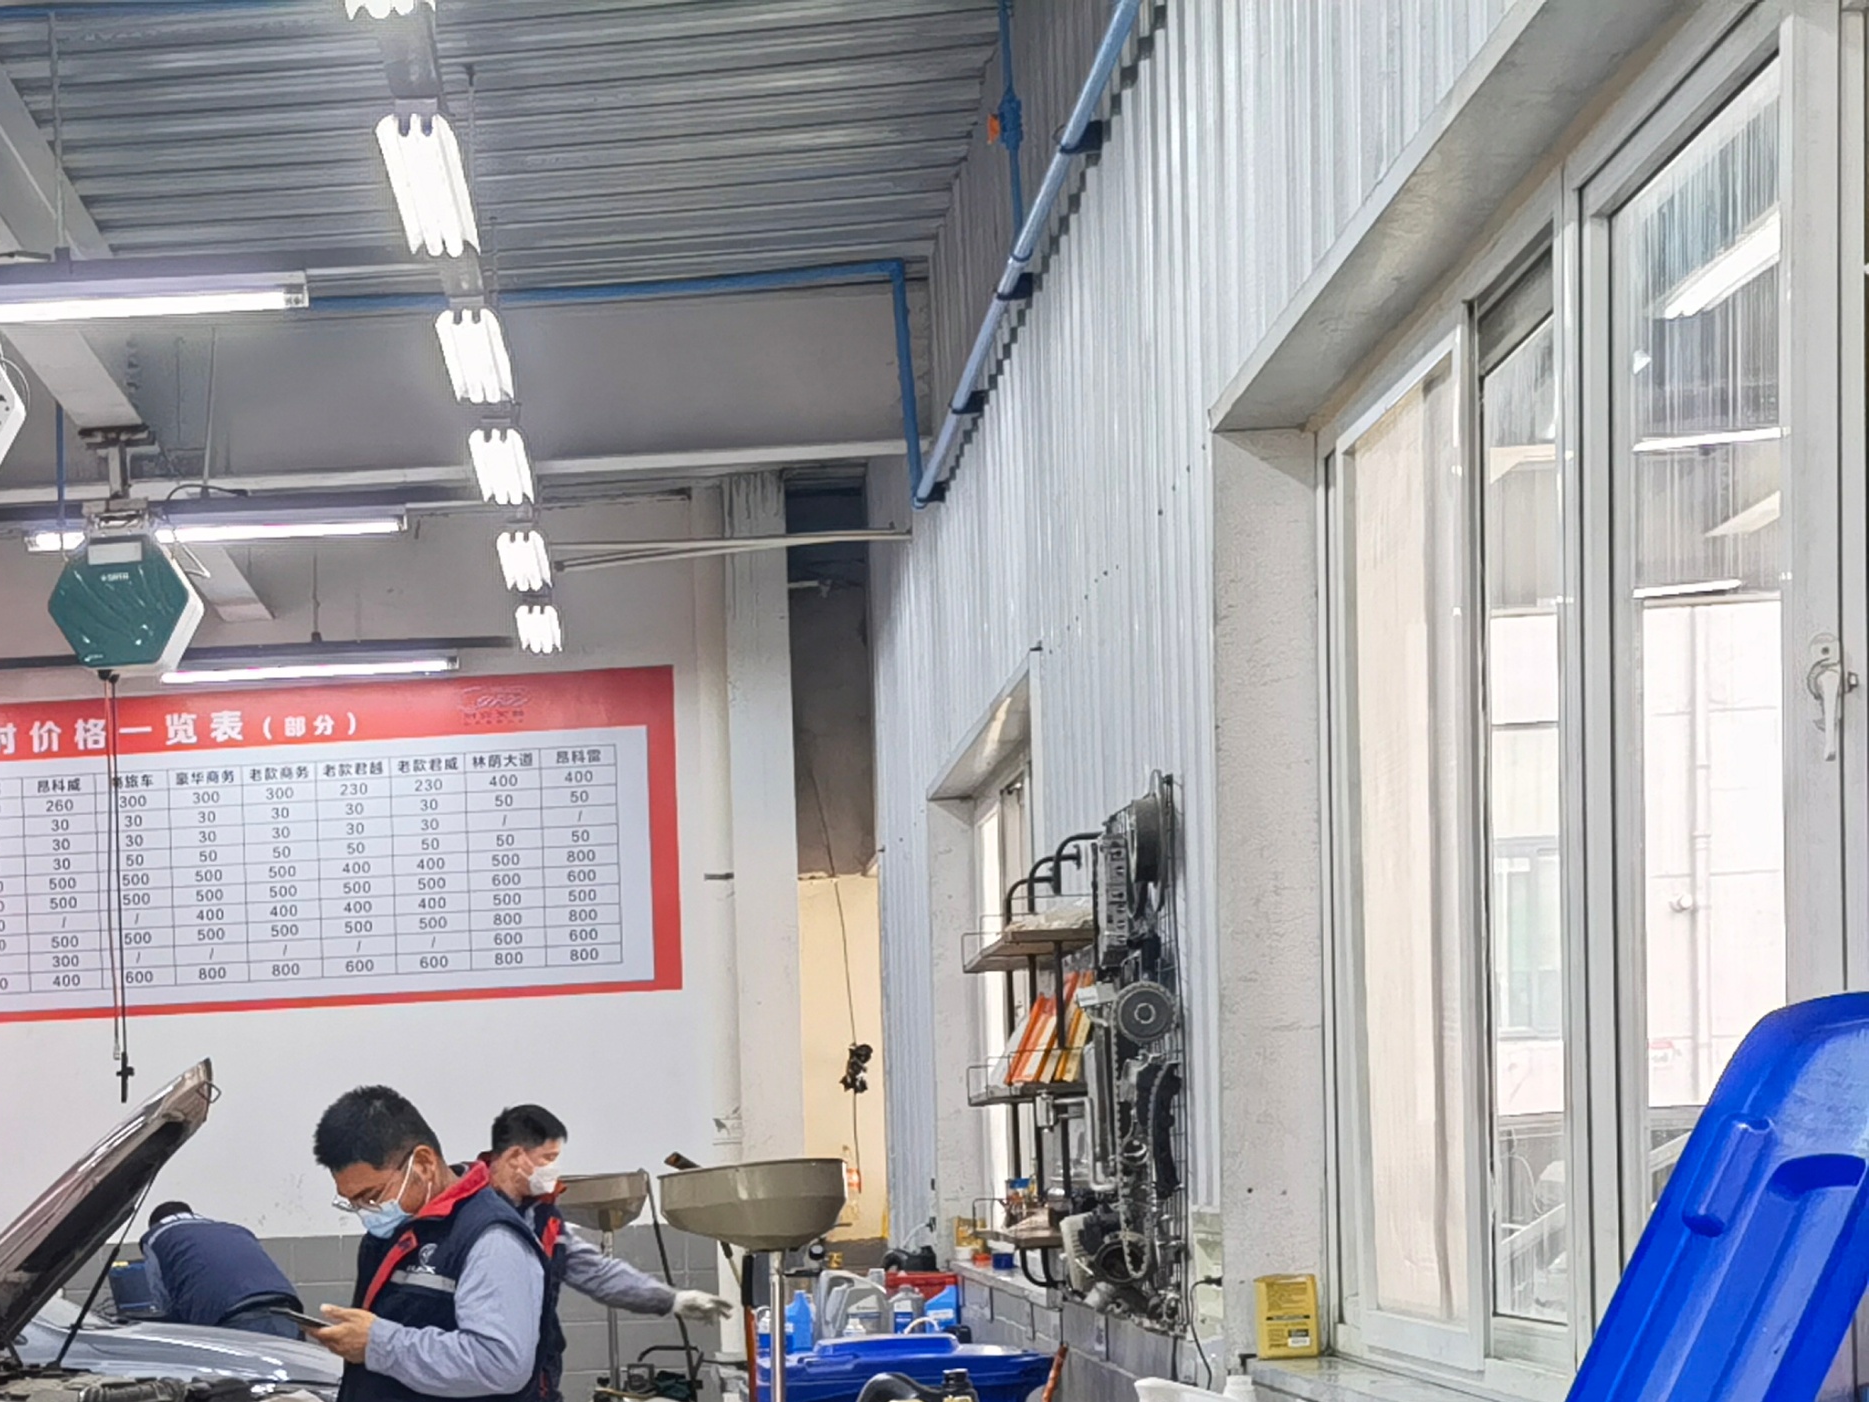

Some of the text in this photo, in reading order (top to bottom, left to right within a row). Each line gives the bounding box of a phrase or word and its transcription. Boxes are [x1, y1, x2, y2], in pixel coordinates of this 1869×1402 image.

[46, 798, 74, 812] 260
[119, 796, 147, 809] 300
[192, 790, 220, 804] 300
[266, 786, 294, 800] 300
[340, 782, 368, 796] 230
[414, 778, 442, 792] 230
[488, 773, 518, 788] 400
[564, 769, 594, 784] 400
[175, 769, 235, 786] 豪华商务
[249, 766, 310, 782] 老款商务
[322, 760, 384, 777] 老款君越
[397, 756, 459, 774] 老款君威
[50, 818, 70, 832] 30
[124, 814, 142, 828] 30
[198, 810, 216, 824] 30
[272, 806, 290, 820] 30
[346, 802, 364, 816] 30
[420, 798, 438, 812] 30
[494, 793, 514, 808] 50
[570, 789, 590, 804] 50
[52, 837, 70, 852] 30
[126, 834, 144, 848] 30
[198, 830, 216, 844] 30
[272, 825, 290, 840] 30
[346, 821, 364, 836] 30
[420, 817, 440, 832] 30
[54, 857, 70, 870] 30
[126, 853, 144, 866] 50
[198, 849, 218, 862] 50
[272, 845, 292, 858] 50
[346, 841, 366, 856] 50
[422, 837, 440, 850] 50
[496, 833, 514, 848] 50
[572, 828, 590, 844] 50
[48, 876, 76, 890] 500
[122, 874, 150, 887] 500
[194, 868, 222, 882] 500
[268, 865, 296, 878] 500
[342, 860, 370, 874] 400
[416, 856, 446, 870] 400
[492, 852, 520, 866] 500
[566, 848, 596, 864] 800
[50, 895, 78, 910] 500
[123, 893, 151, 906] 500
[196, 888, 224, 902] 500
[270, 884, 298, 898] 500
[342, 880, 372, 894] 500
[418, 876, 446, 890] 500
[492, 872, 522, 886] 600
[566, 868, 596, 882] 600
[196, 907, 224, 922] 400
[270, 904, 298, 918] 400
[344, 900, 372, 914] 400
[418, 896, 446, 910] 400
[492, 892, 522, 906] 500
[568, 888, 596, 902] 500
[50, 934, 78, 948] 500
[124, 932, 152, 945] 500
[198, 927, 226, 942] 500
[270, 923, 300, 938] 500
[344, 919, 372, 934] 500
[418, 915, 448, 930] 500
[492, 912, 522, 926] 800
[568, 908, 598, 922] 800
[52, 954, 80, 968] 300
[494, 931, 522, 946] 600
[568, 927, 598, 942] 600
[52, 973, 80, 988] 400
[126, 971, 153, 984] 600
[198, 966, 226, 980] 800
[272, 962, 300, 976] 800
[344, 958, 374, 972] 600
[420, 955, 448, 968] 600
[494, 951, 524, 966] 800
[570, 947, 600, 962] 800
